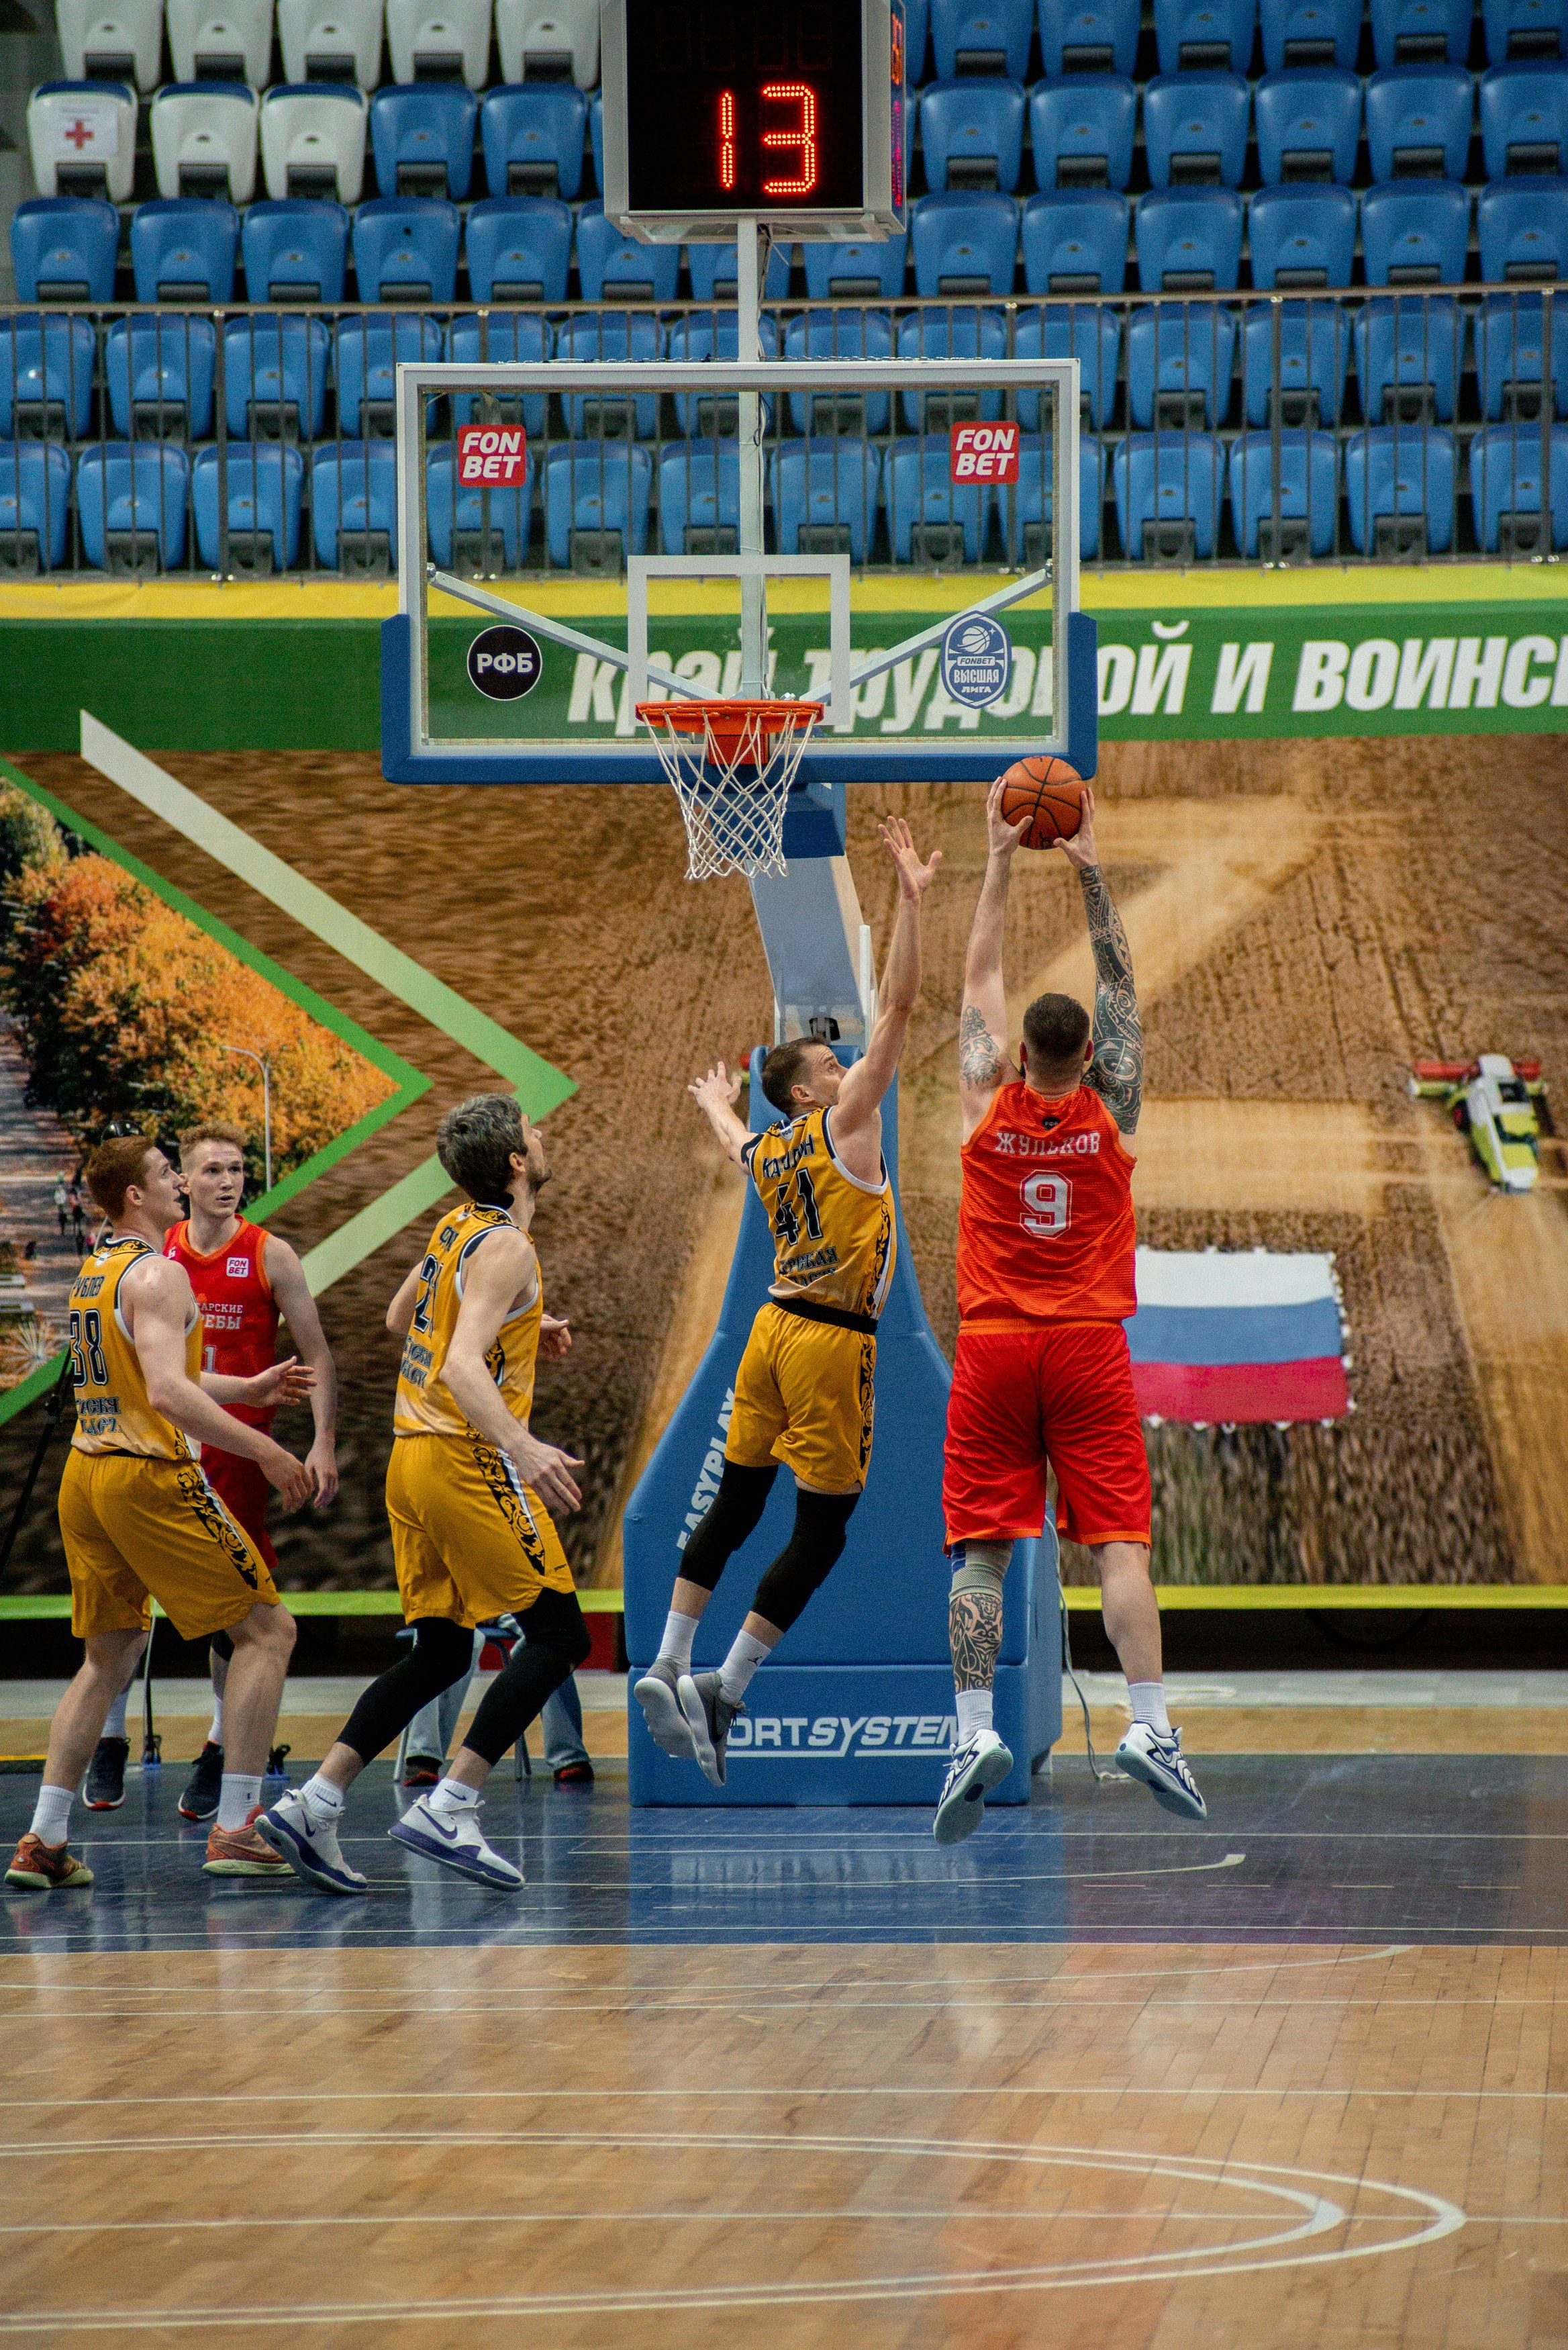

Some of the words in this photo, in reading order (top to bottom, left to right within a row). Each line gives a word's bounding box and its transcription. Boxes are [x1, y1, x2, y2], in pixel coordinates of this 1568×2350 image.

[720, 85, 816, 193] 13
[462, 432, 521, 454] FON
[955, 428, 1015, 451] FON
[462, 455, 521, 478] BET
[955, 453, 1015, 475] BET
[476, 651, 534, 673] РФБ
[953, 669, 999, 684] ВЫСШАЯ
[961, 686, 992, 694] ЛИГА
[775, 1167, 824, 1248] 41
[1020, 1169, 1073, 1240] 9
[228, 1260, 247, 1268] FON
[228, 1267, 247, 1275] BET
[70, 1308, 109, 1388] 38
[726, 1715, 959, 1757] ORTSYSTEM
